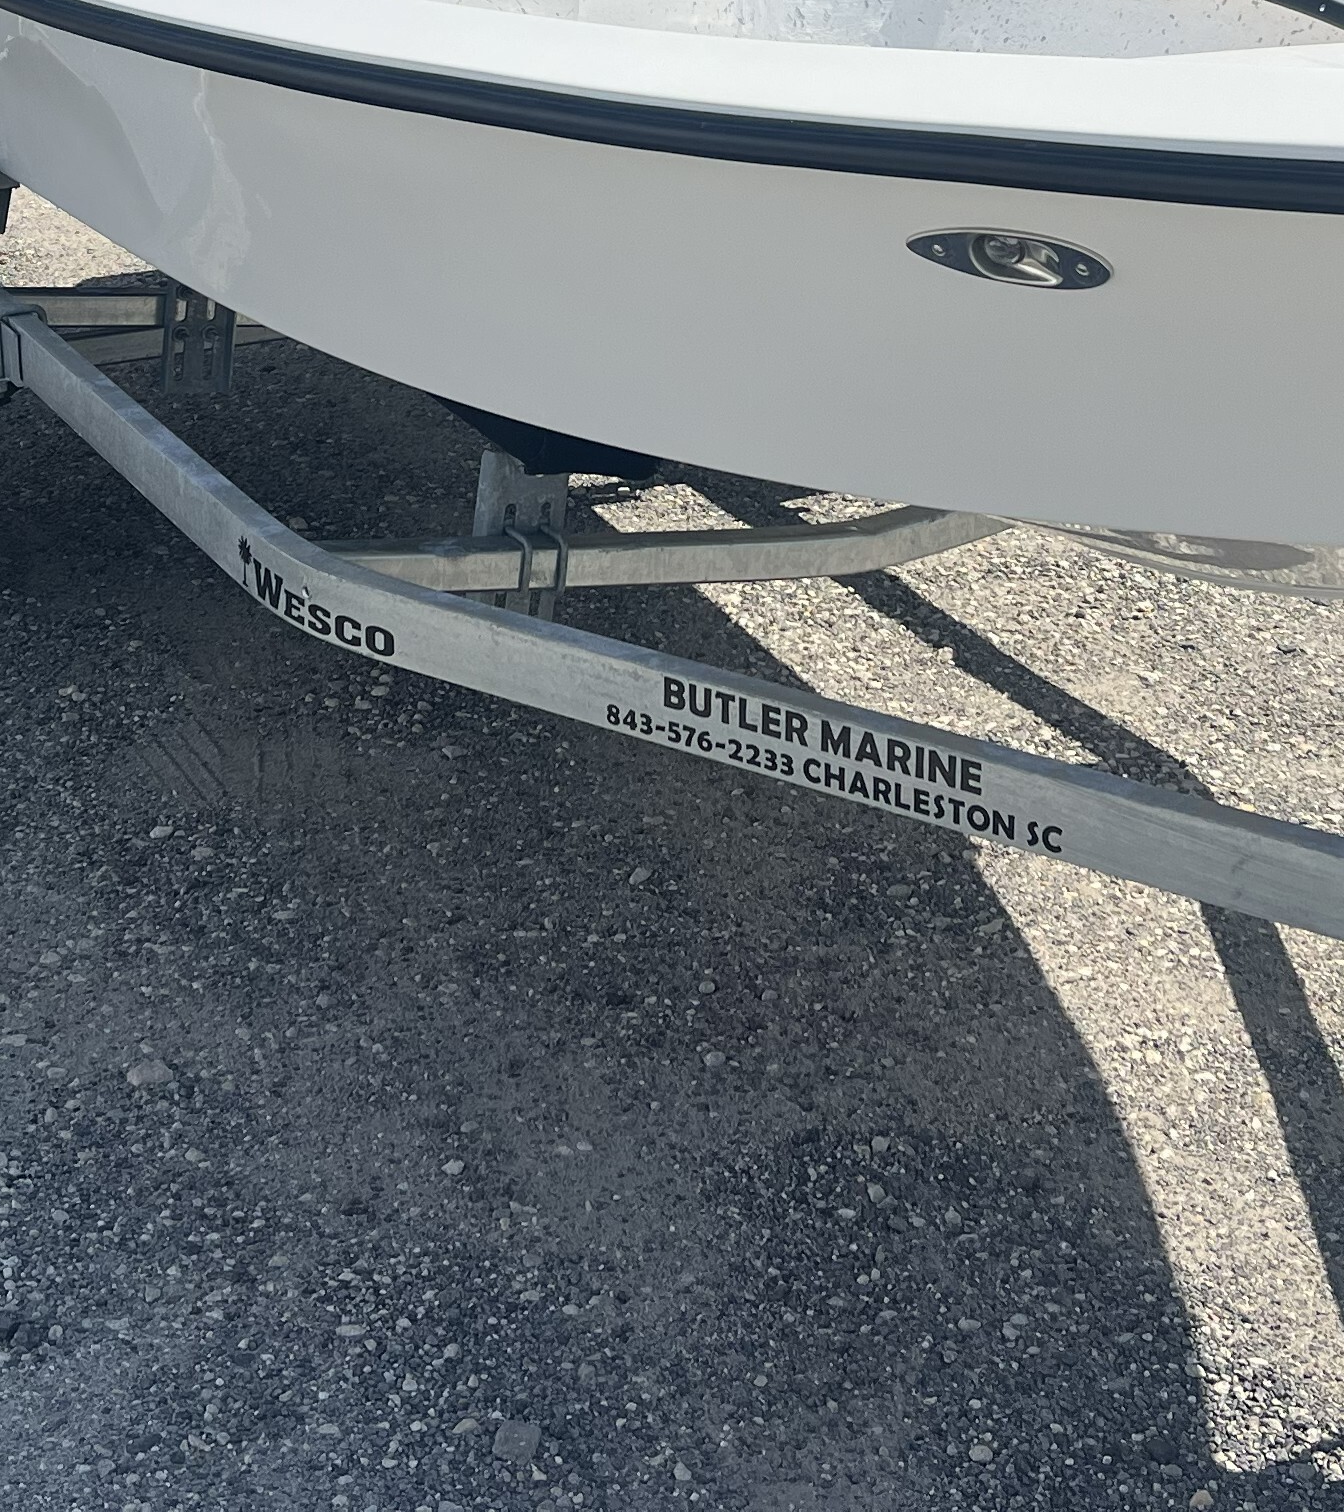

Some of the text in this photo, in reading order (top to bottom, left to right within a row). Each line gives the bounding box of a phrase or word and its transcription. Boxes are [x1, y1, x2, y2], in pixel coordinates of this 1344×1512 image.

[606, 704, 1064, 853] 843-576-2233 CHARLESTON SC
[663, 675, 983, 796] BUTLER MARINE
